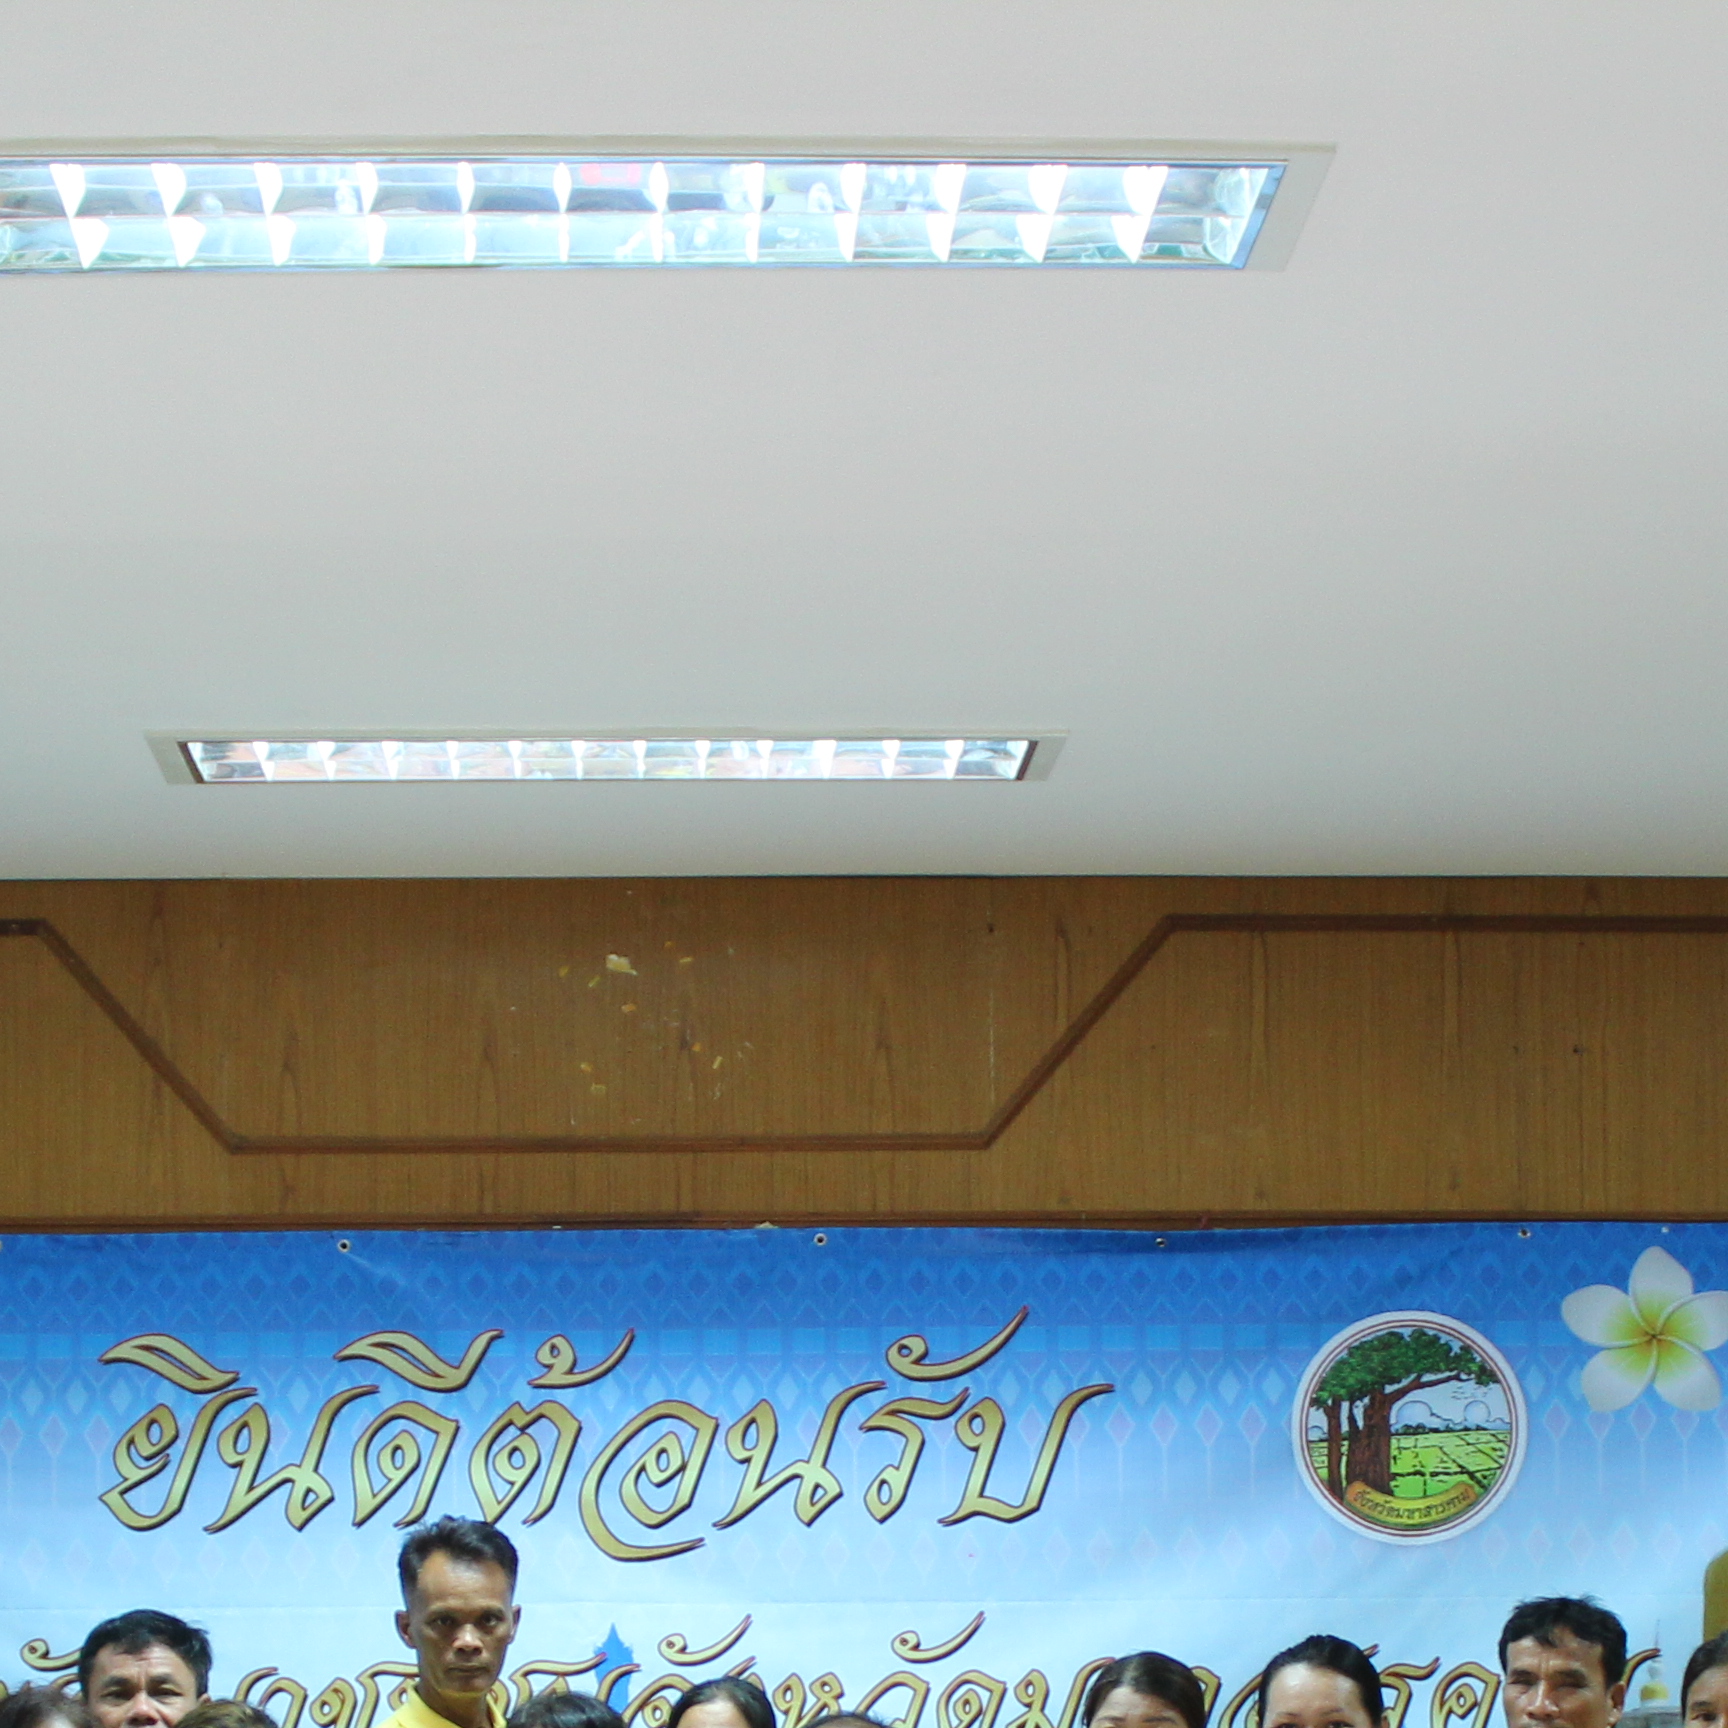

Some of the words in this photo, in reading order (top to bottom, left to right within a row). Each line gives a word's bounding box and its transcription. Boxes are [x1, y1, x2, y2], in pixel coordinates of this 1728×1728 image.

[97, 1305, 1115, 1562] ยินดีต้อนรับ
